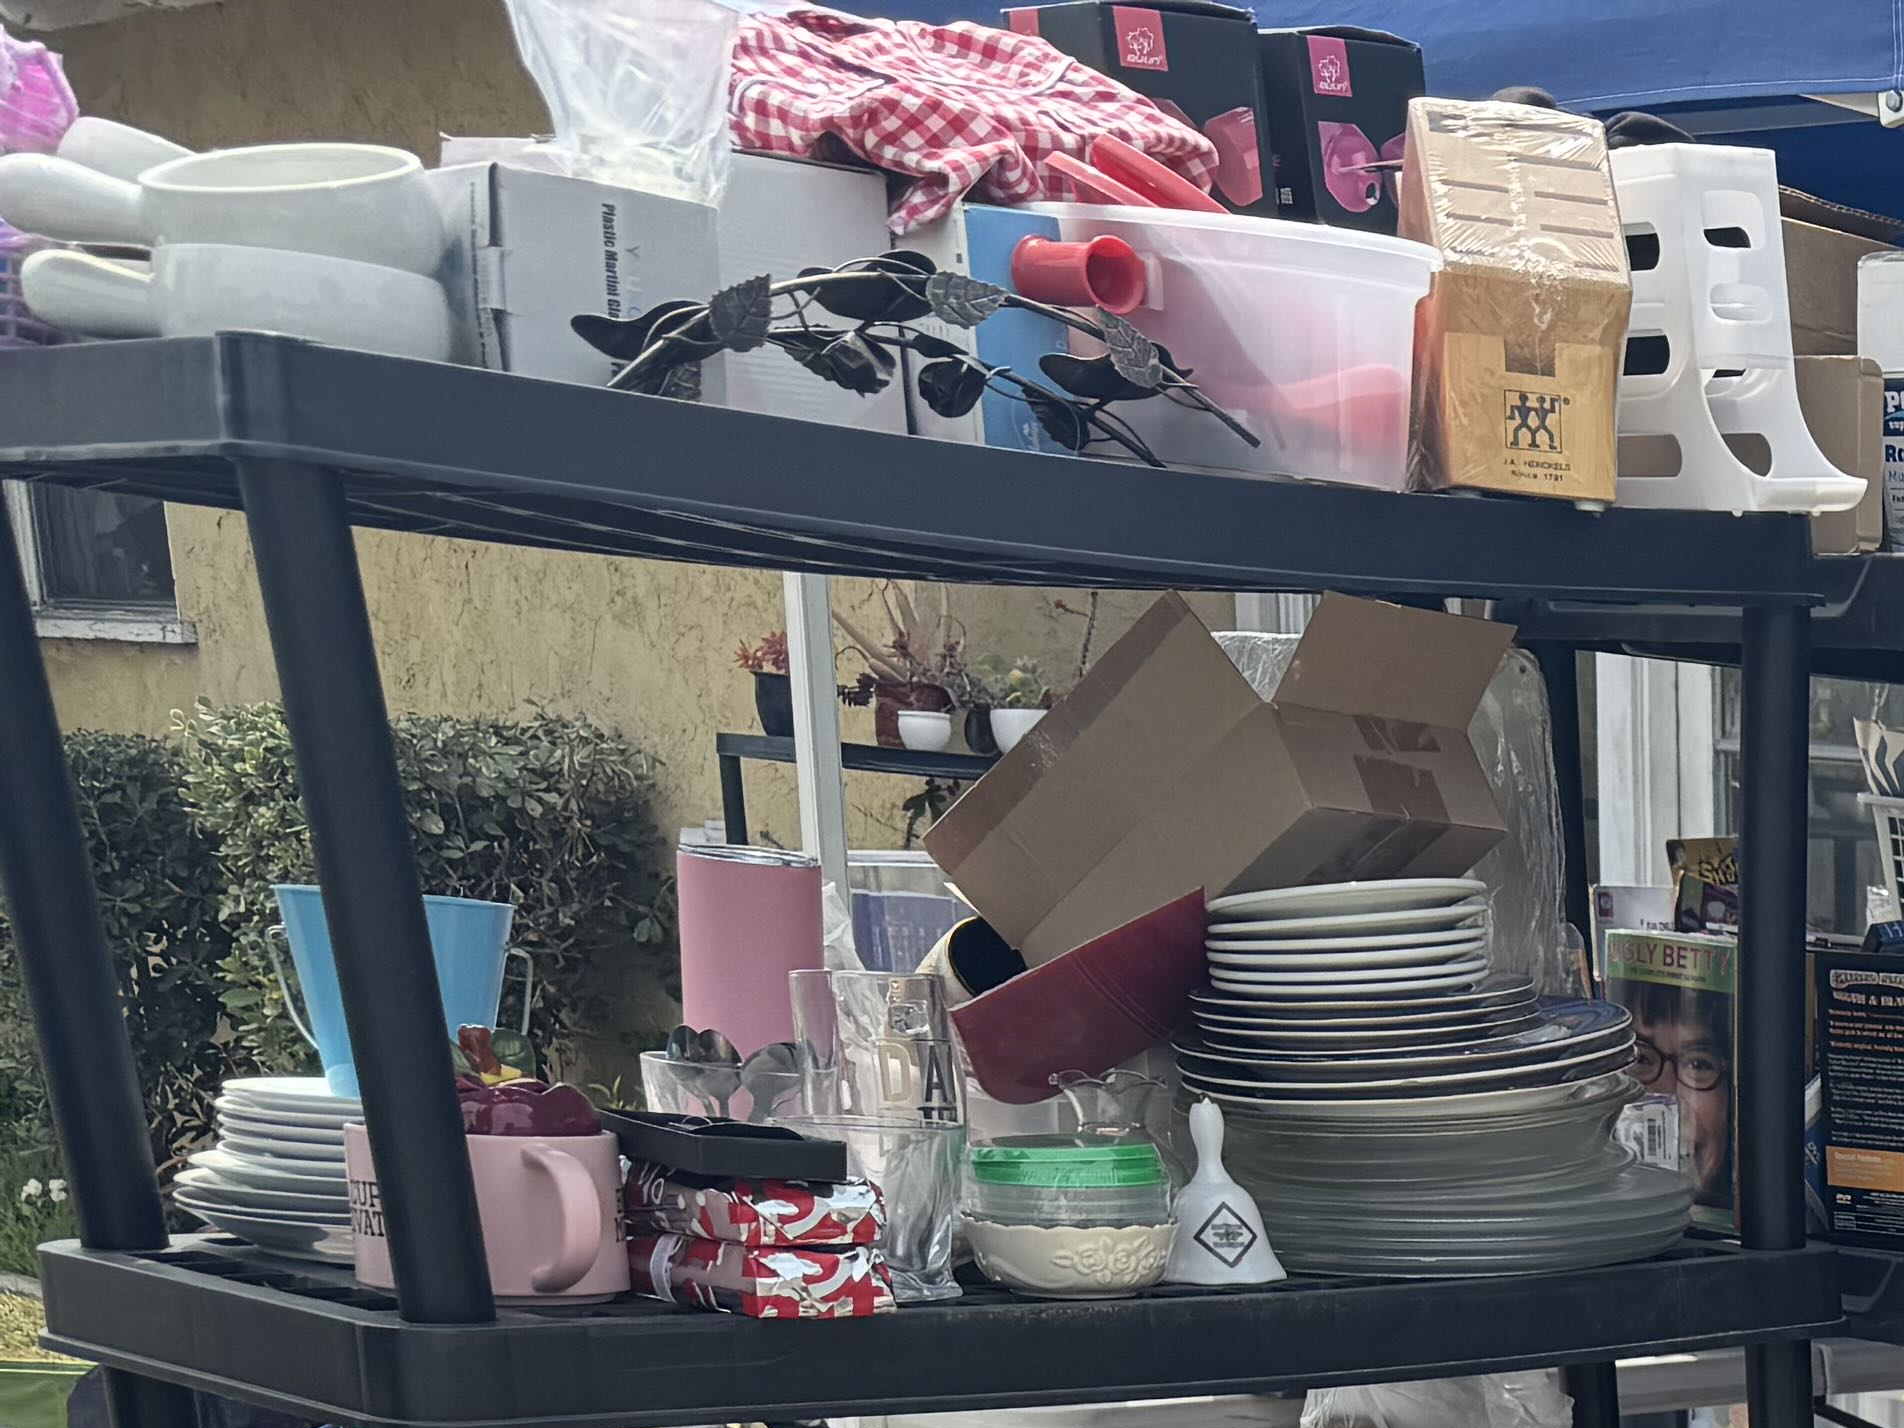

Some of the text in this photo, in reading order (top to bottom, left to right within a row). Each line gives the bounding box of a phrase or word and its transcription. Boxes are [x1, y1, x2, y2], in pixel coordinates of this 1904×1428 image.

[601, 203, 620, 297] Plastic Martini
[1663, 944, 1730, 977] BETTY
